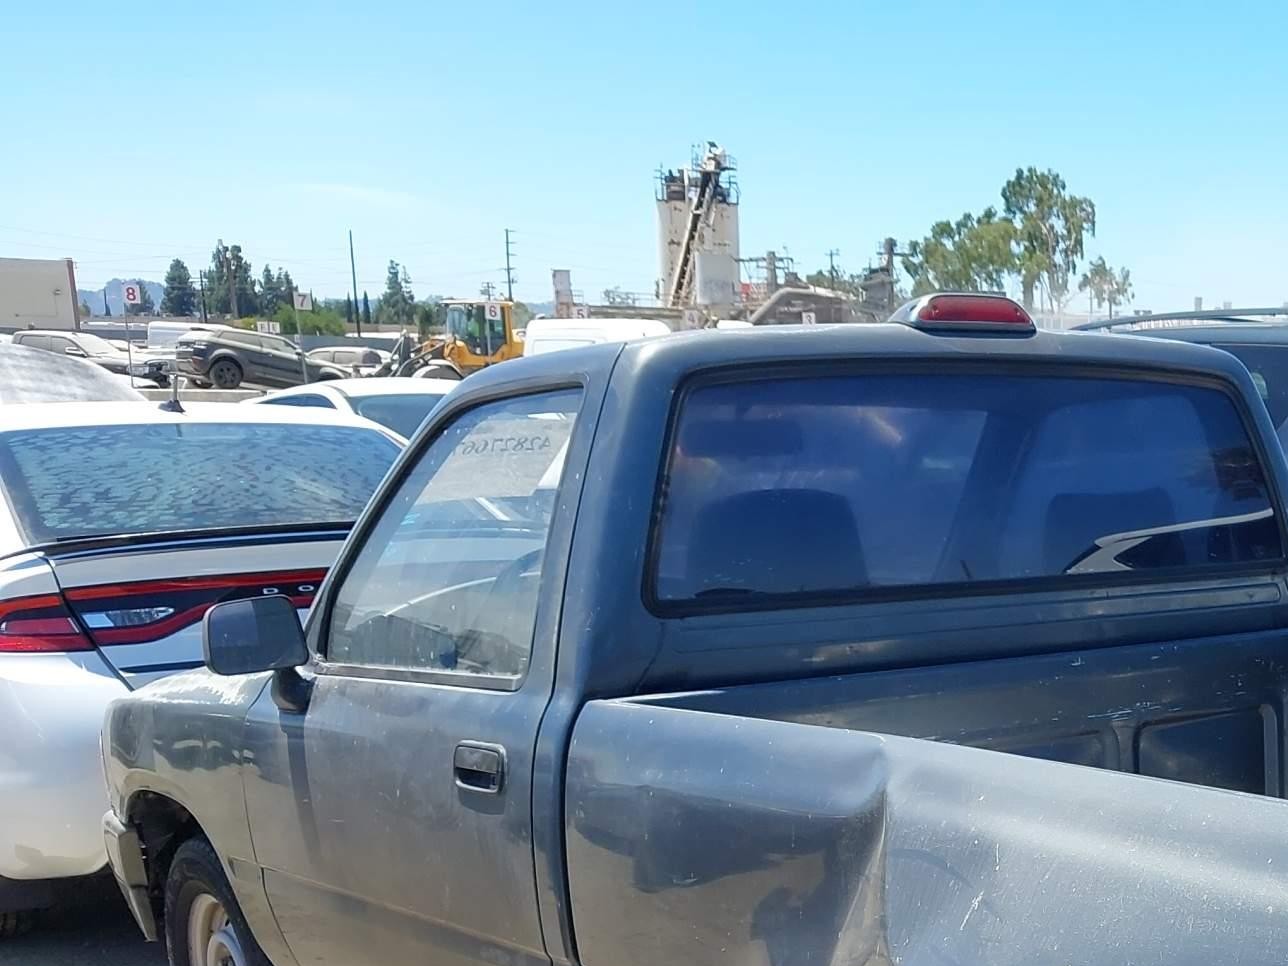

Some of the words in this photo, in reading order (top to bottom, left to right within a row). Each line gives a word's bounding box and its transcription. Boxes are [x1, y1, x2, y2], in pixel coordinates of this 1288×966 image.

[126, 287, 137, 302] 8
[298, 294, 308, 307] 7
[489, 305, 498, 318] 6
[576, 308, 585, 319] 5
